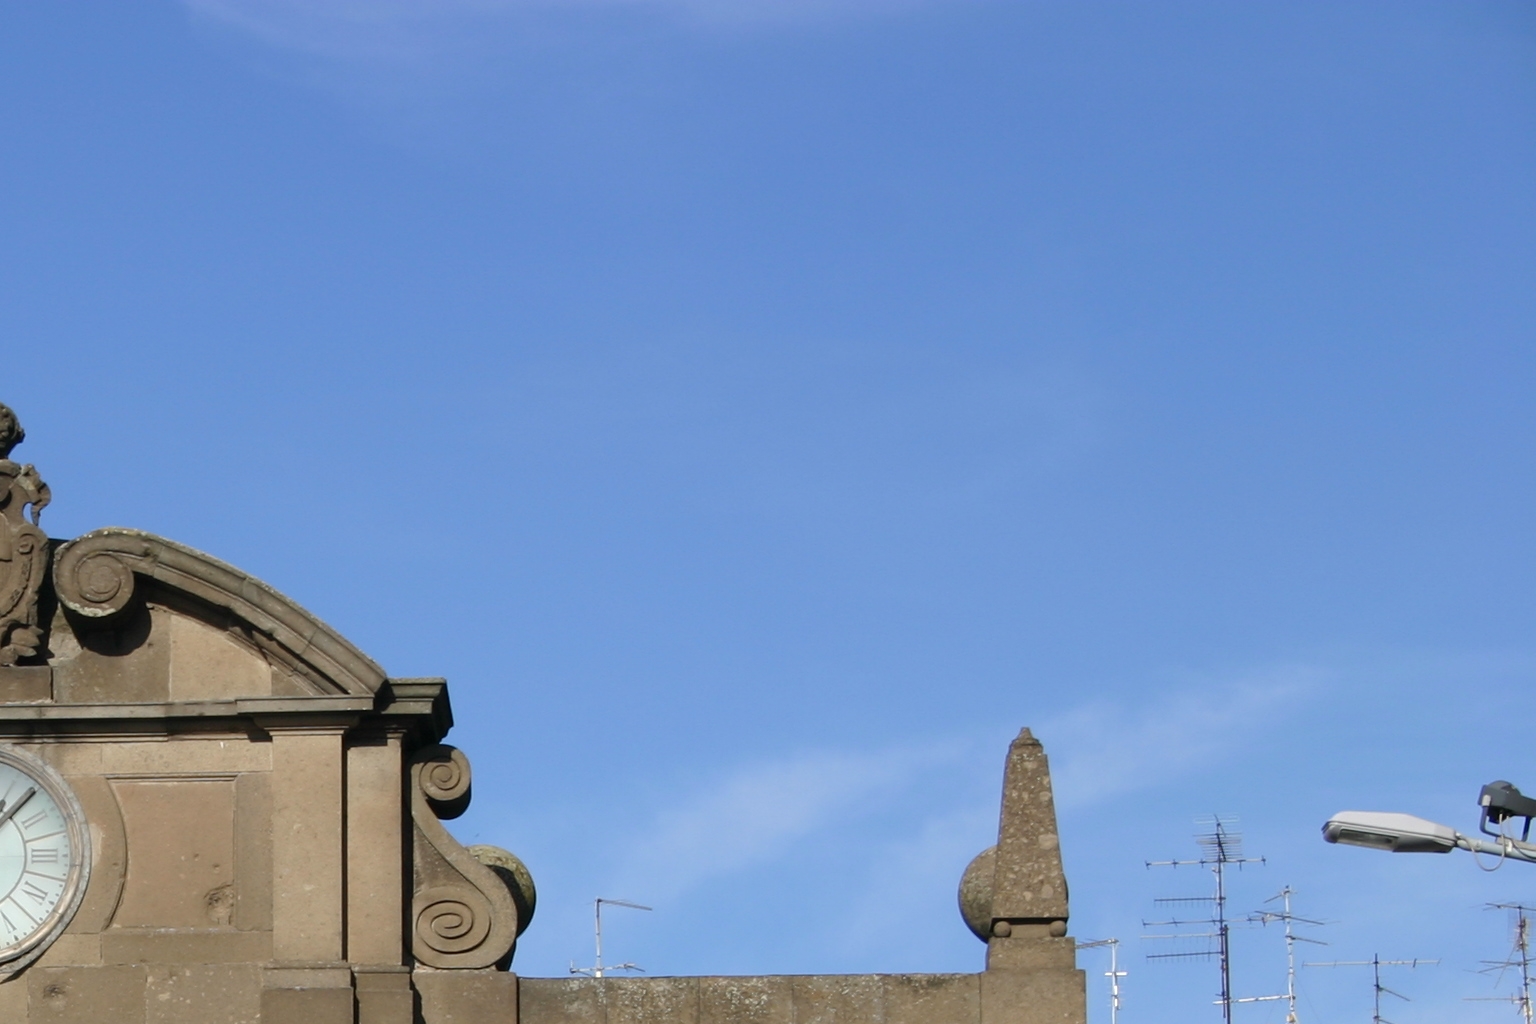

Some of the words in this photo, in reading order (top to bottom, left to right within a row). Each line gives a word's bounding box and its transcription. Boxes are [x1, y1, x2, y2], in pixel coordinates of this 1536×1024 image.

[21, 809, 48, 830] II
[31, 848, 58, 864] III
[21, 880, 48, 906] IV
[0, 910, 17, 934] V
